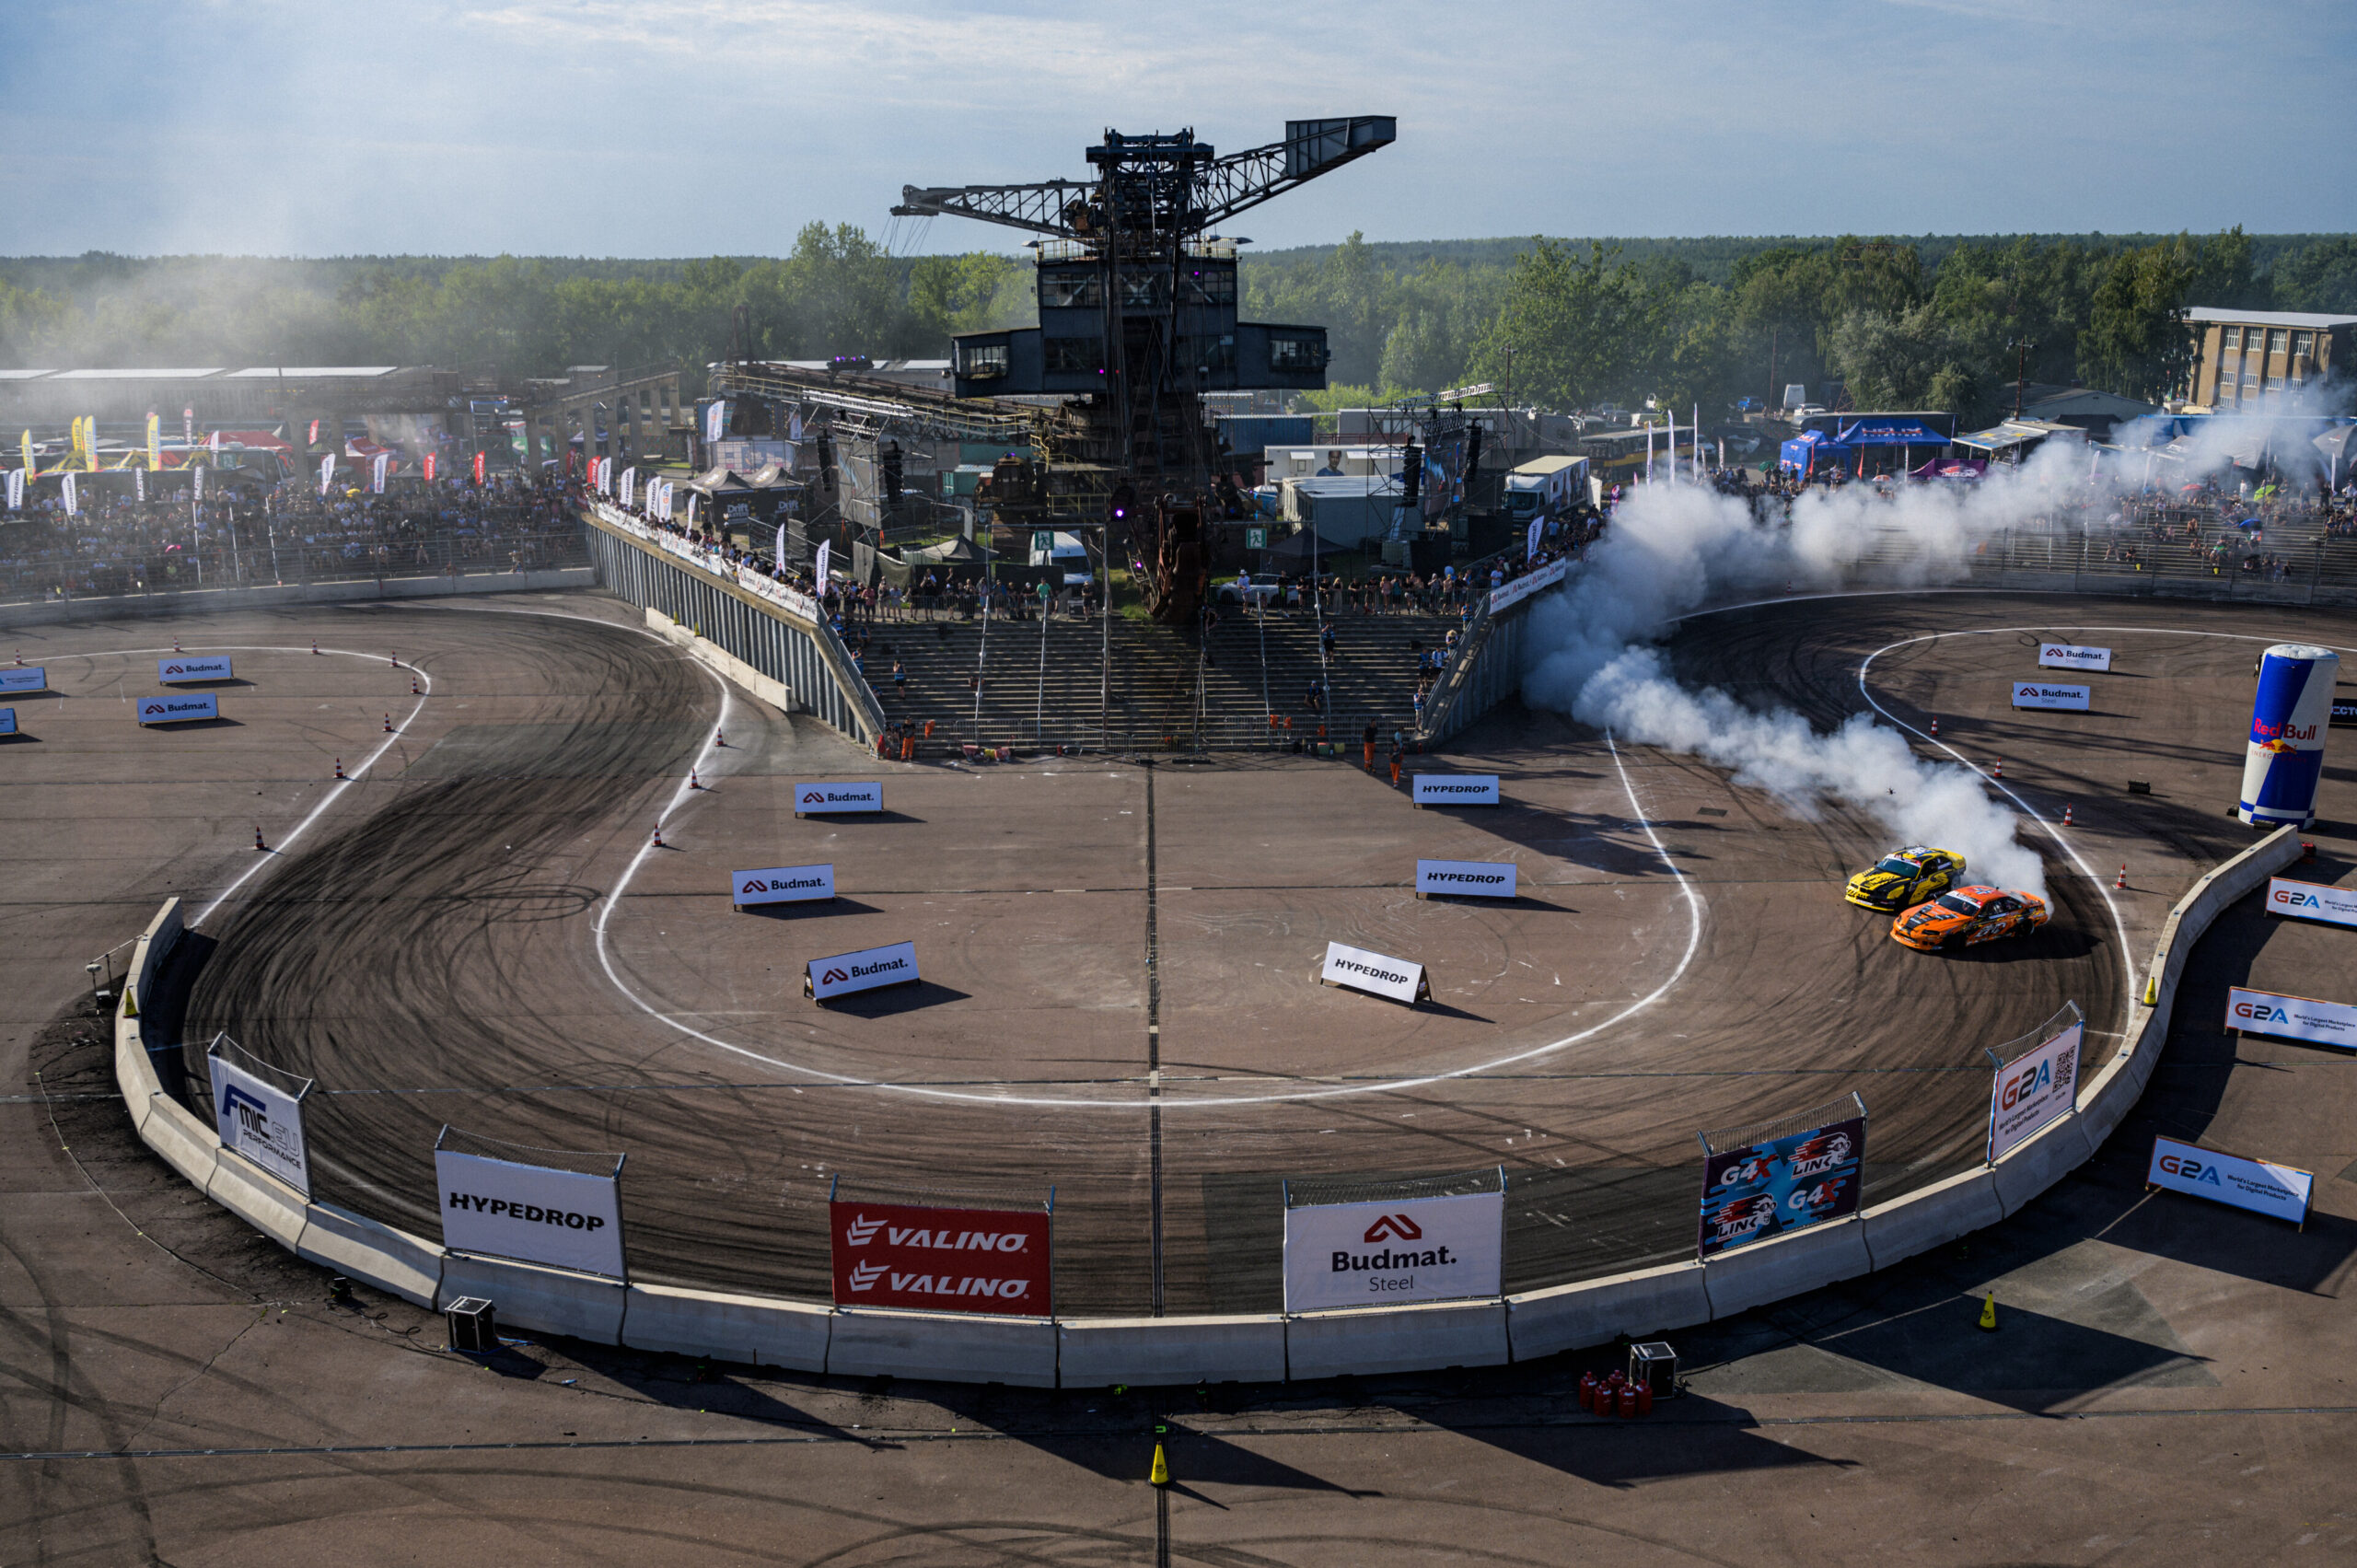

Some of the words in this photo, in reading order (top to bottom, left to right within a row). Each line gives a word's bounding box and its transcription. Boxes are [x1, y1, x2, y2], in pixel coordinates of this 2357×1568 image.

[727, 503, 749, 513] Drift
[2066, 650, 2104, 660] Budmat.
[186, 664, 225, 673] Budmat.
[2041, 689, 2084, 699] Budmat.
[168, 702, 211, 713] Budmat.
[2330, 706, 2357, 715] ECT
[2254, 718, 2281, 738] Red
[2283, 724, 2316, 740] Bull
[828, 793, 874, 802] Budmat.
[1422, 785, 1490, 794] HYPEDROP
[772, 877, 826, 890] Budmat.
[1427, 872, 1505, 884] HYPEDROP
[2274, 890, 2319, 909] G2A
[851, 958, 909, 977] Budmat.
[1335, 958, 1409, 984] HYPEDROP
[2235, 1003, 2289, 1024] G2A
[2002, 1059, 2050, 1111] G2A
[243, 1128, 302, 1169] PERFORMANCE
[1721, 1154, 1778, 1185] G4X
[1793, 1156, 1832, 1176] LINK
[2159, 1155, 2221, 1186] G2A
[1788, 1178, 1841, 1209] G4X
[2227, 1175, 2247, 1184] World's
[2247, 1179, 2266, 1189] Largest
[2268, 1184, 2299, 1197] Marketplace
[2246, 1186, 2262, 1195] Digital
[2263, 1189, 2286, 1201] Products
[449, 1192, 605, 1232] HYPEDROP
[1717, 1216, 1759, 1237] LINK
[888, 1227, 1029, 1252] VALINO
[1331, 1246, 1457, 1272] Budmat.
[890, 1272, 1031, 1298] VALINO
[1369, 1275, 1413, 1291] Steel
